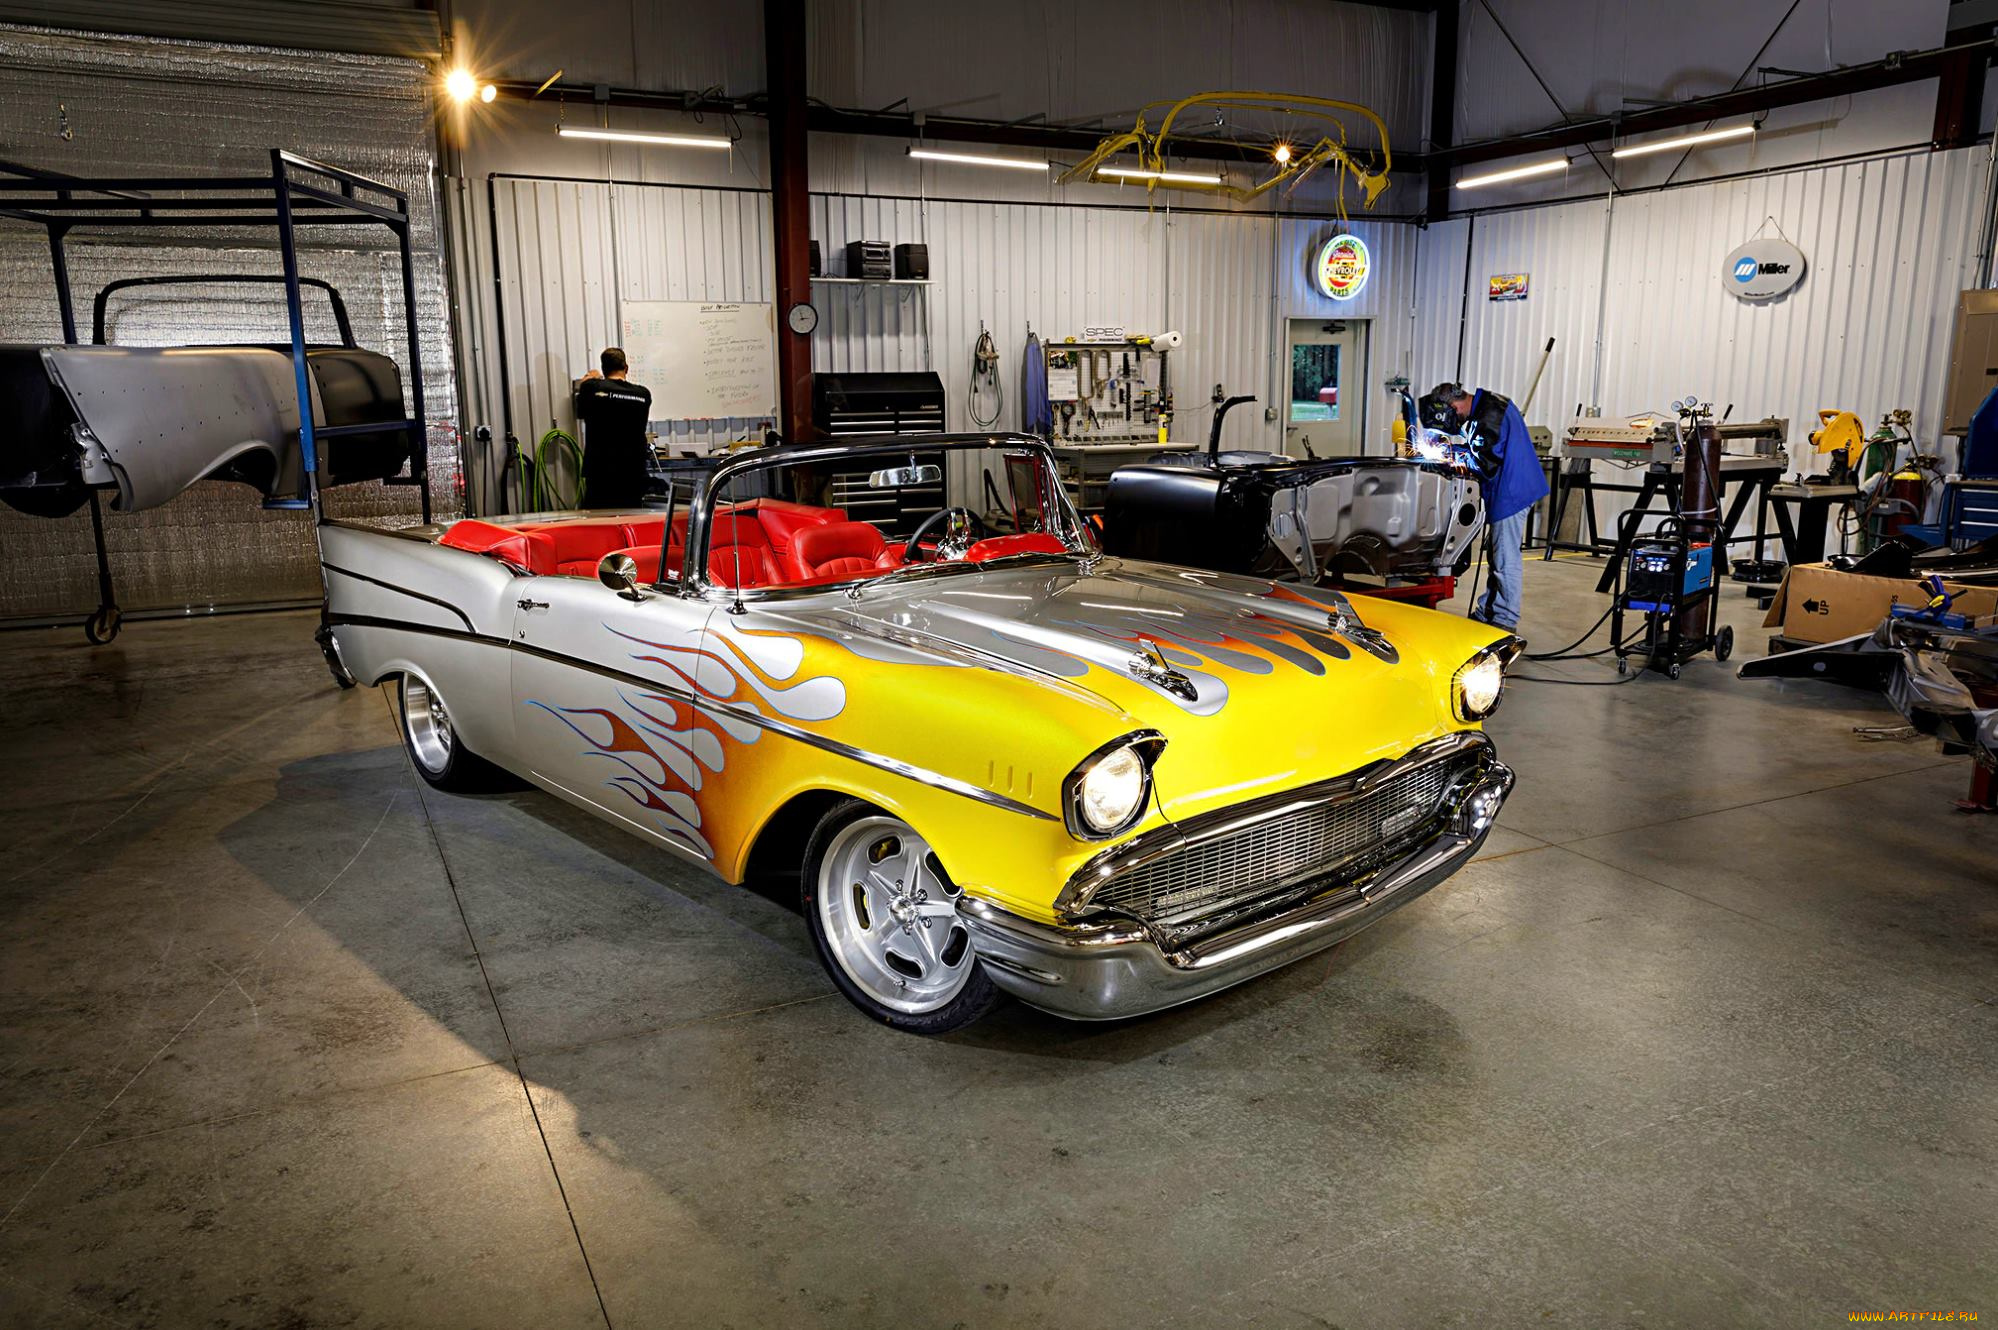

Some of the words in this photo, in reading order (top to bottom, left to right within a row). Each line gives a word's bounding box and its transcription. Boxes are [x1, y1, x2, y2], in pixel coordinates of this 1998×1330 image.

[1758, 263, 1790, 275] Miller
[1086, 327, 1123, 337] SPEC
[1819, 600, 1830, 615] UP
